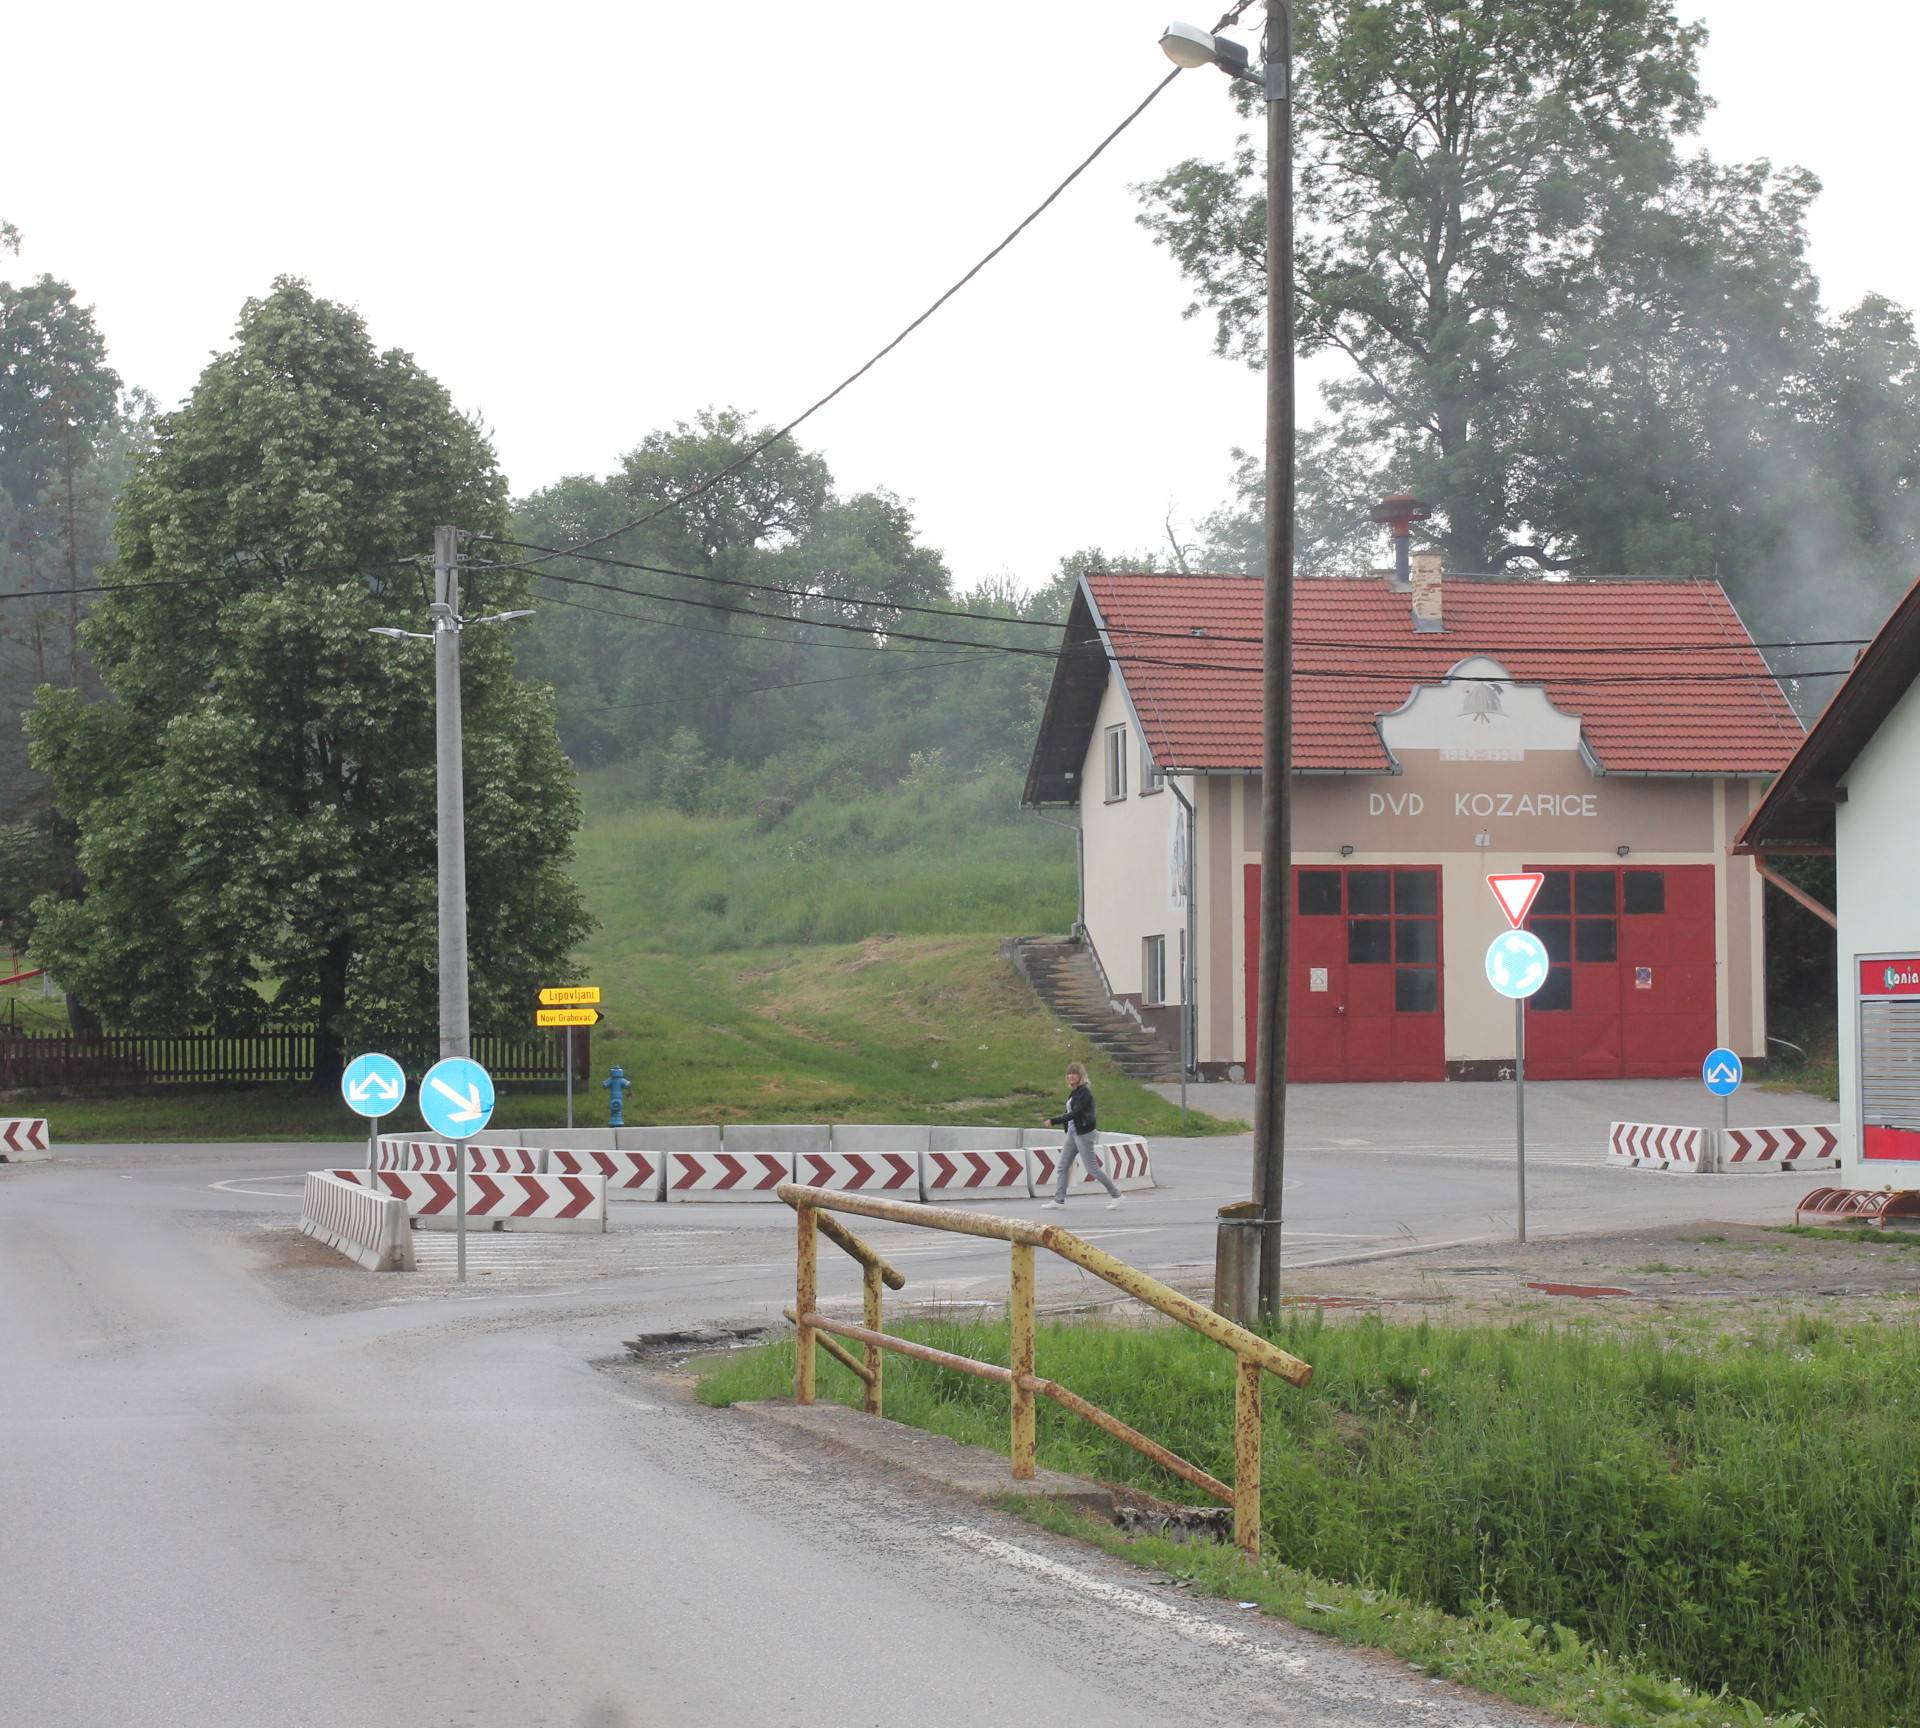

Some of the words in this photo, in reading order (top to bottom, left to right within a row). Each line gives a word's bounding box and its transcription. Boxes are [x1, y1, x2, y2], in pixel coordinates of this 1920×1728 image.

[1369, 793, 1424, 816] DVD
[1455, 793, 1598, 817] KOZARICE
[549, 989, 594, 1003] Lipovljani
[540, 1014, 556, 1023] Novi
[558, 1013, 592, 1023] Grabovac
